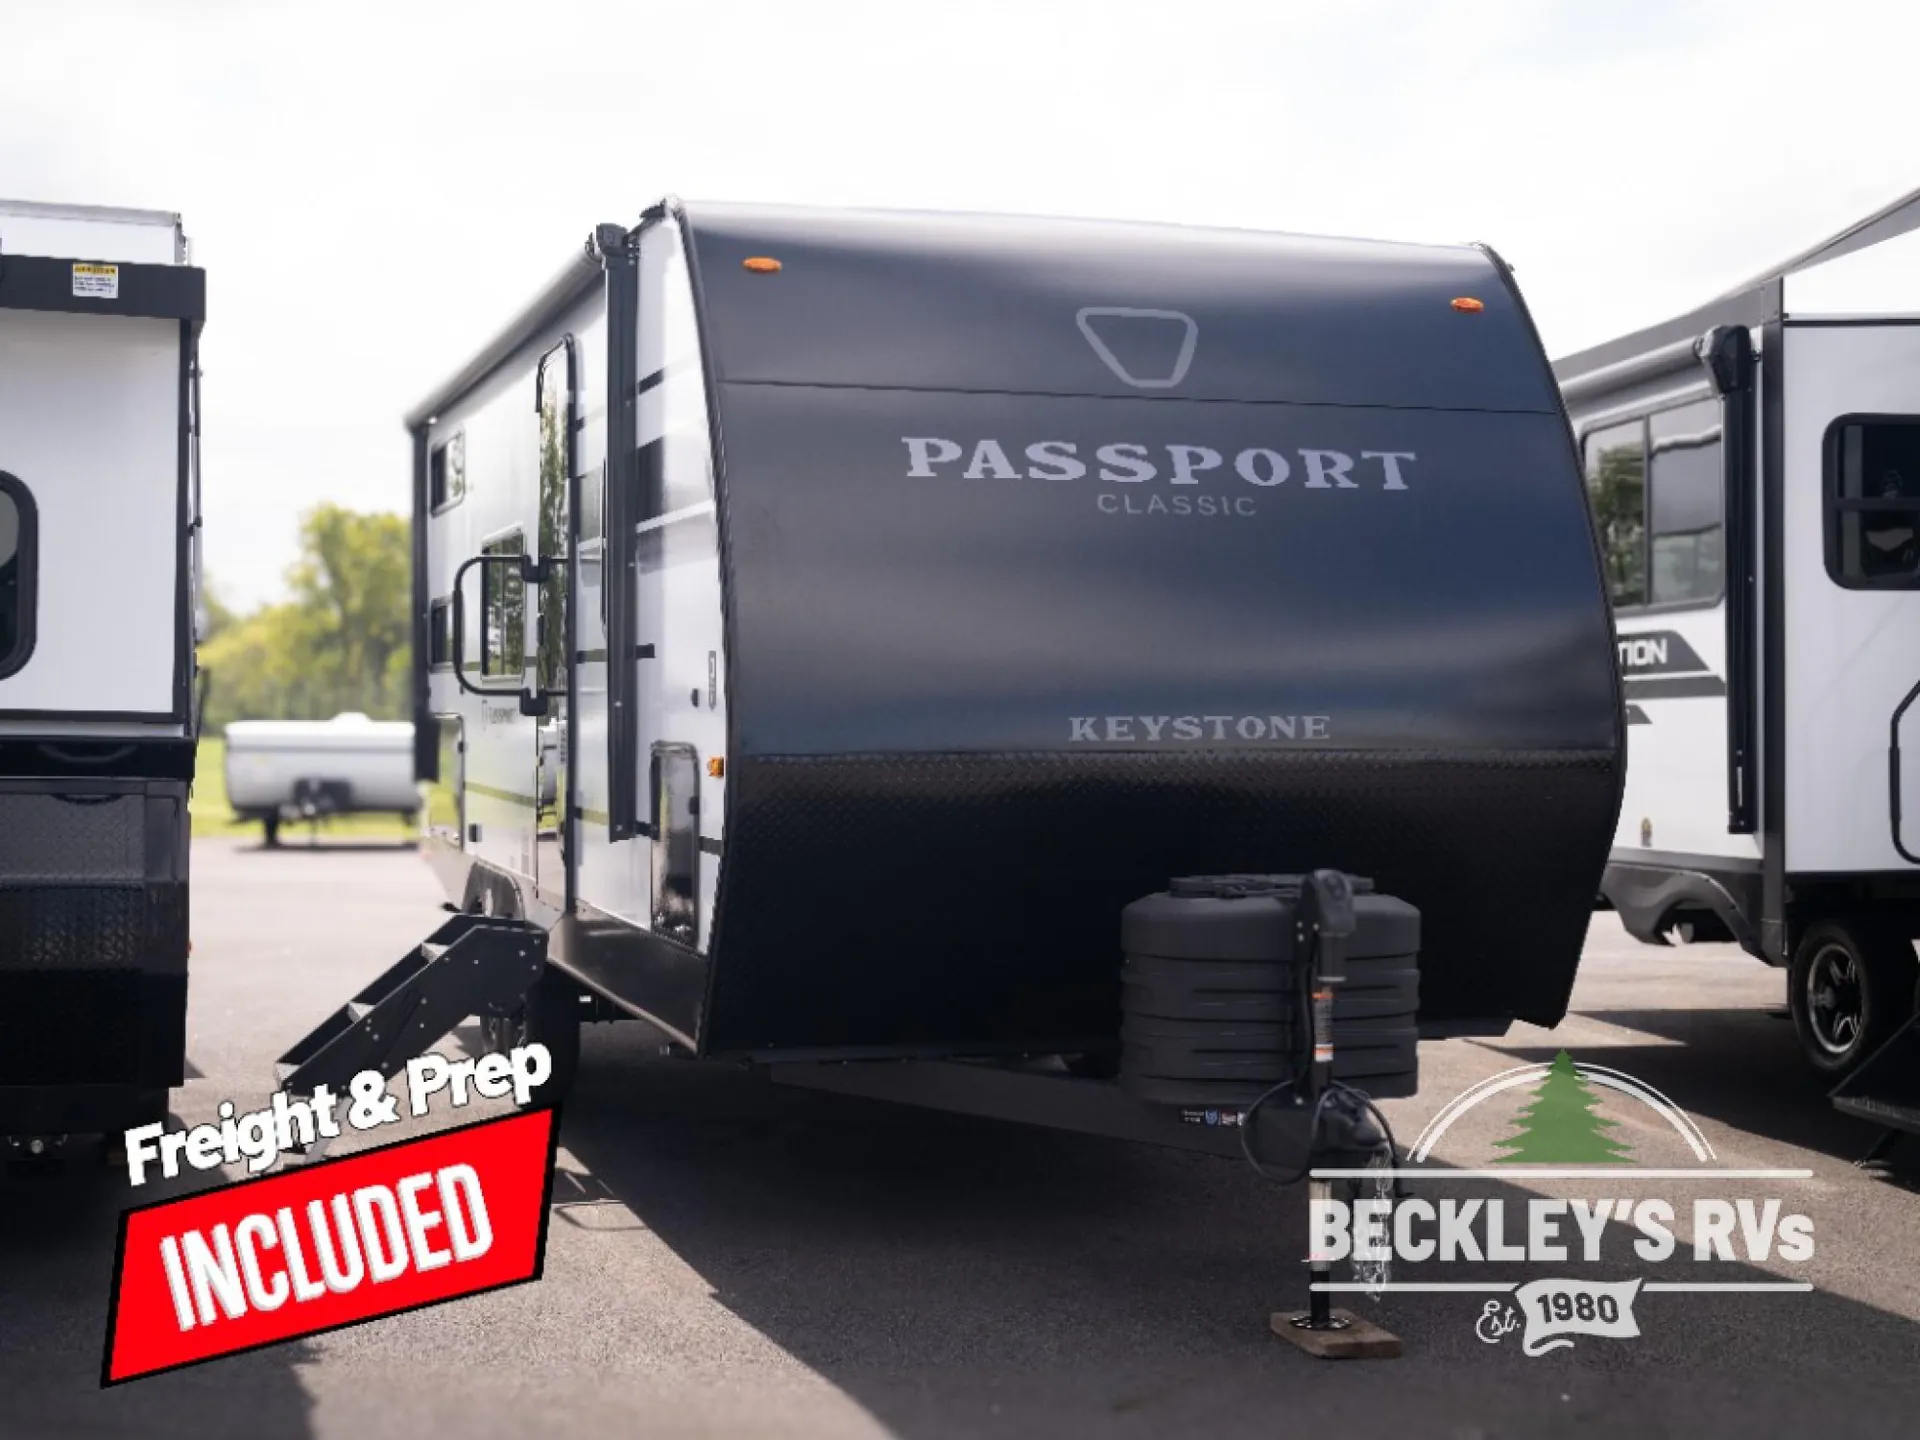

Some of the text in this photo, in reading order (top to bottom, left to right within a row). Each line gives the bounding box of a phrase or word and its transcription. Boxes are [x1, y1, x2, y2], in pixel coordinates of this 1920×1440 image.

[901, 436, 1417, 490] PASSPORT
[1097, 493, 1258, 517] CLASSIC
[1068, 715, 1331, 742] KEYSTONE
